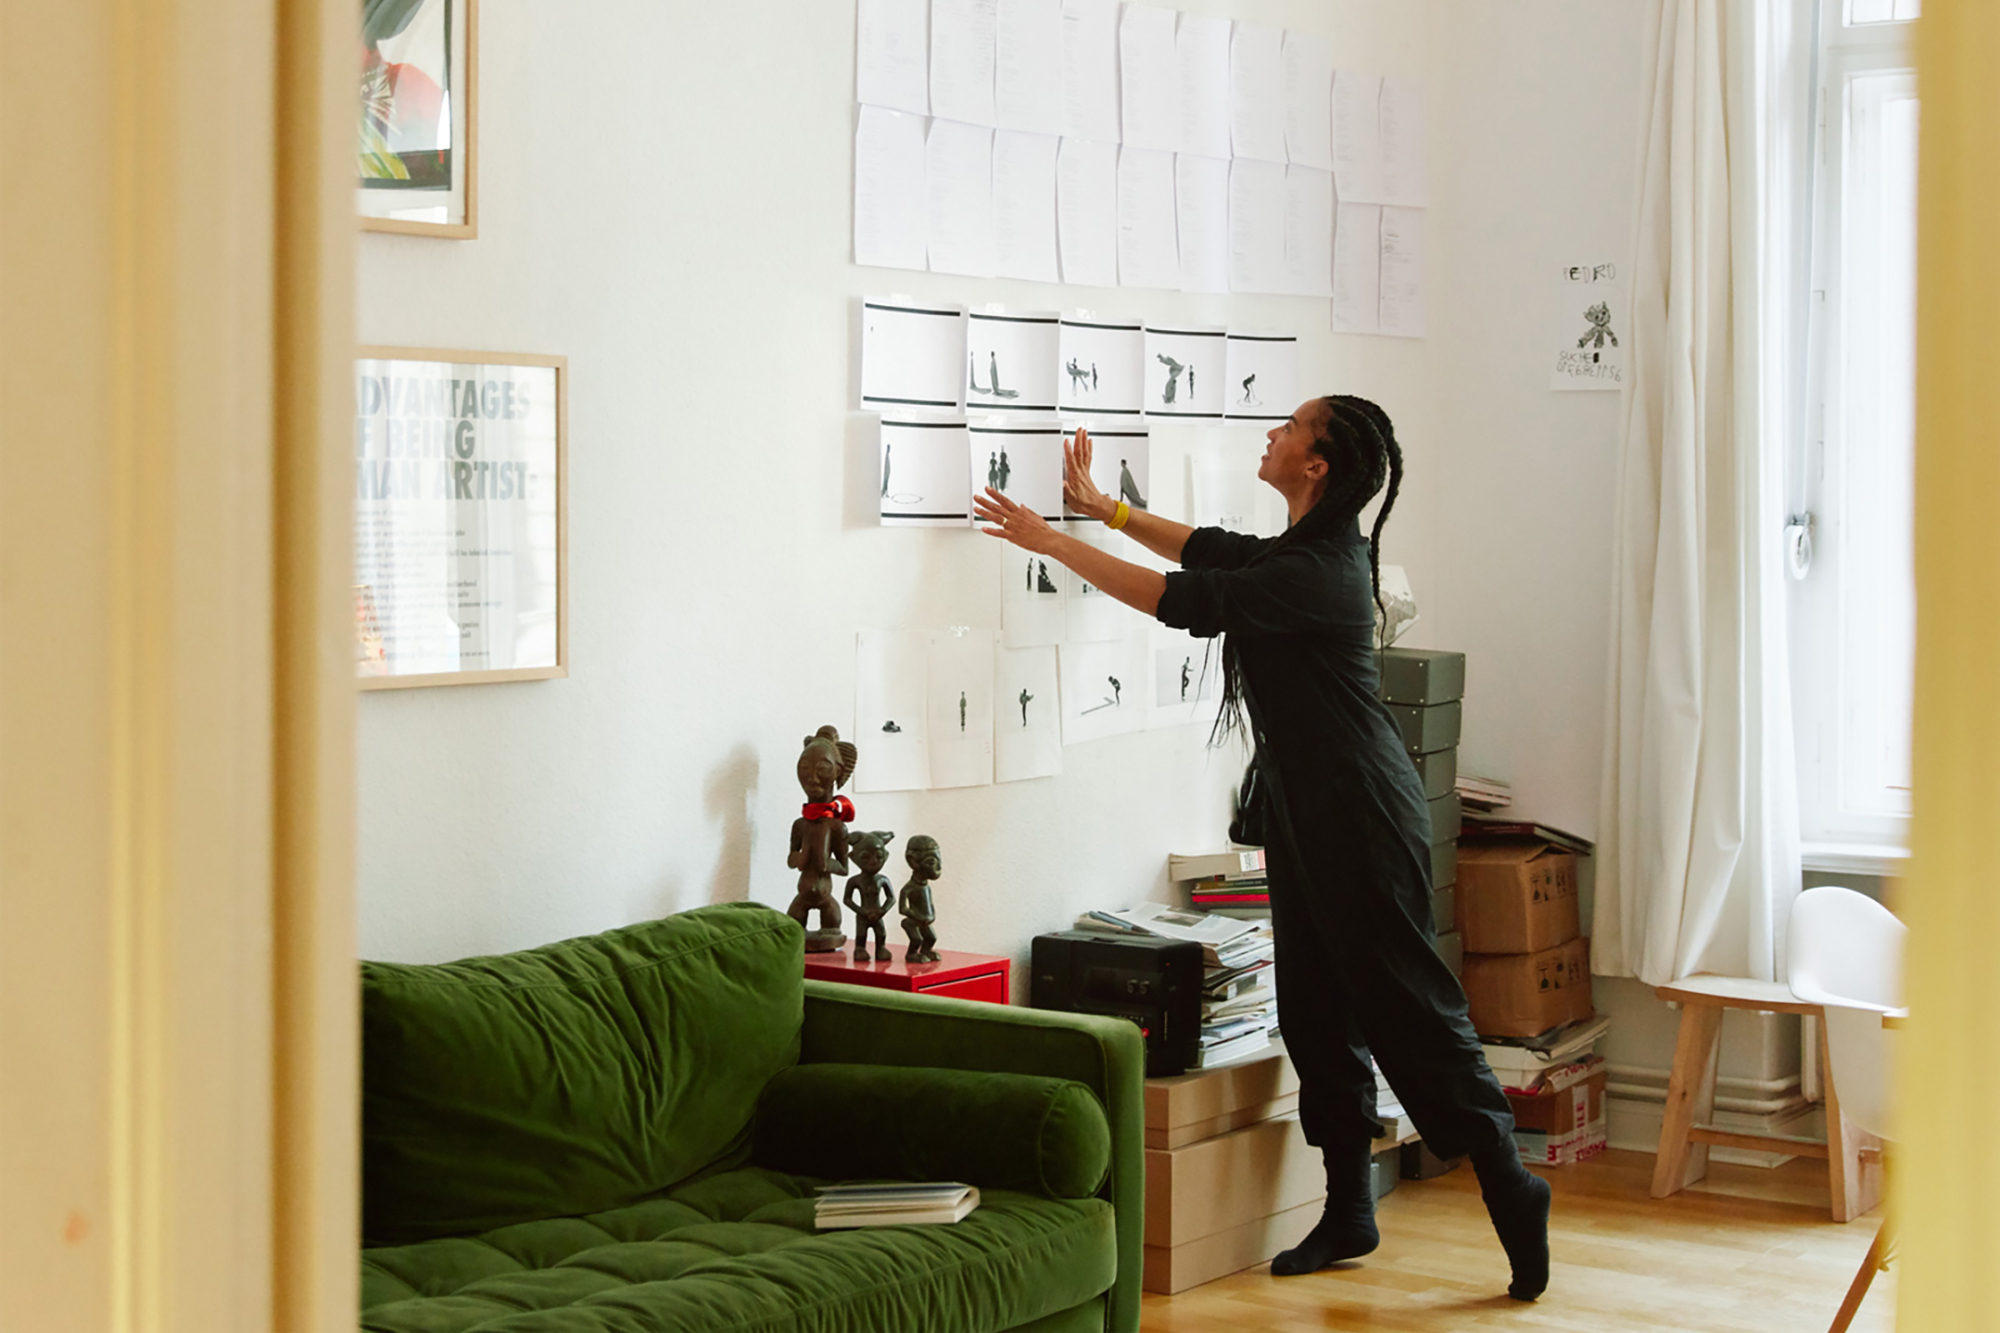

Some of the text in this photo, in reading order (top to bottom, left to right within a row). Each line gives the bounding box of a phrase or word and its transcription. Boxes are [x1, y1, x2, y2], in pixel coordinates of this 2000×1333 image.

[359, 375, 532, 421] DVANTAGES
[357, 417, 476, 460] F BEING
[357, 459, 421, 500] MAN
